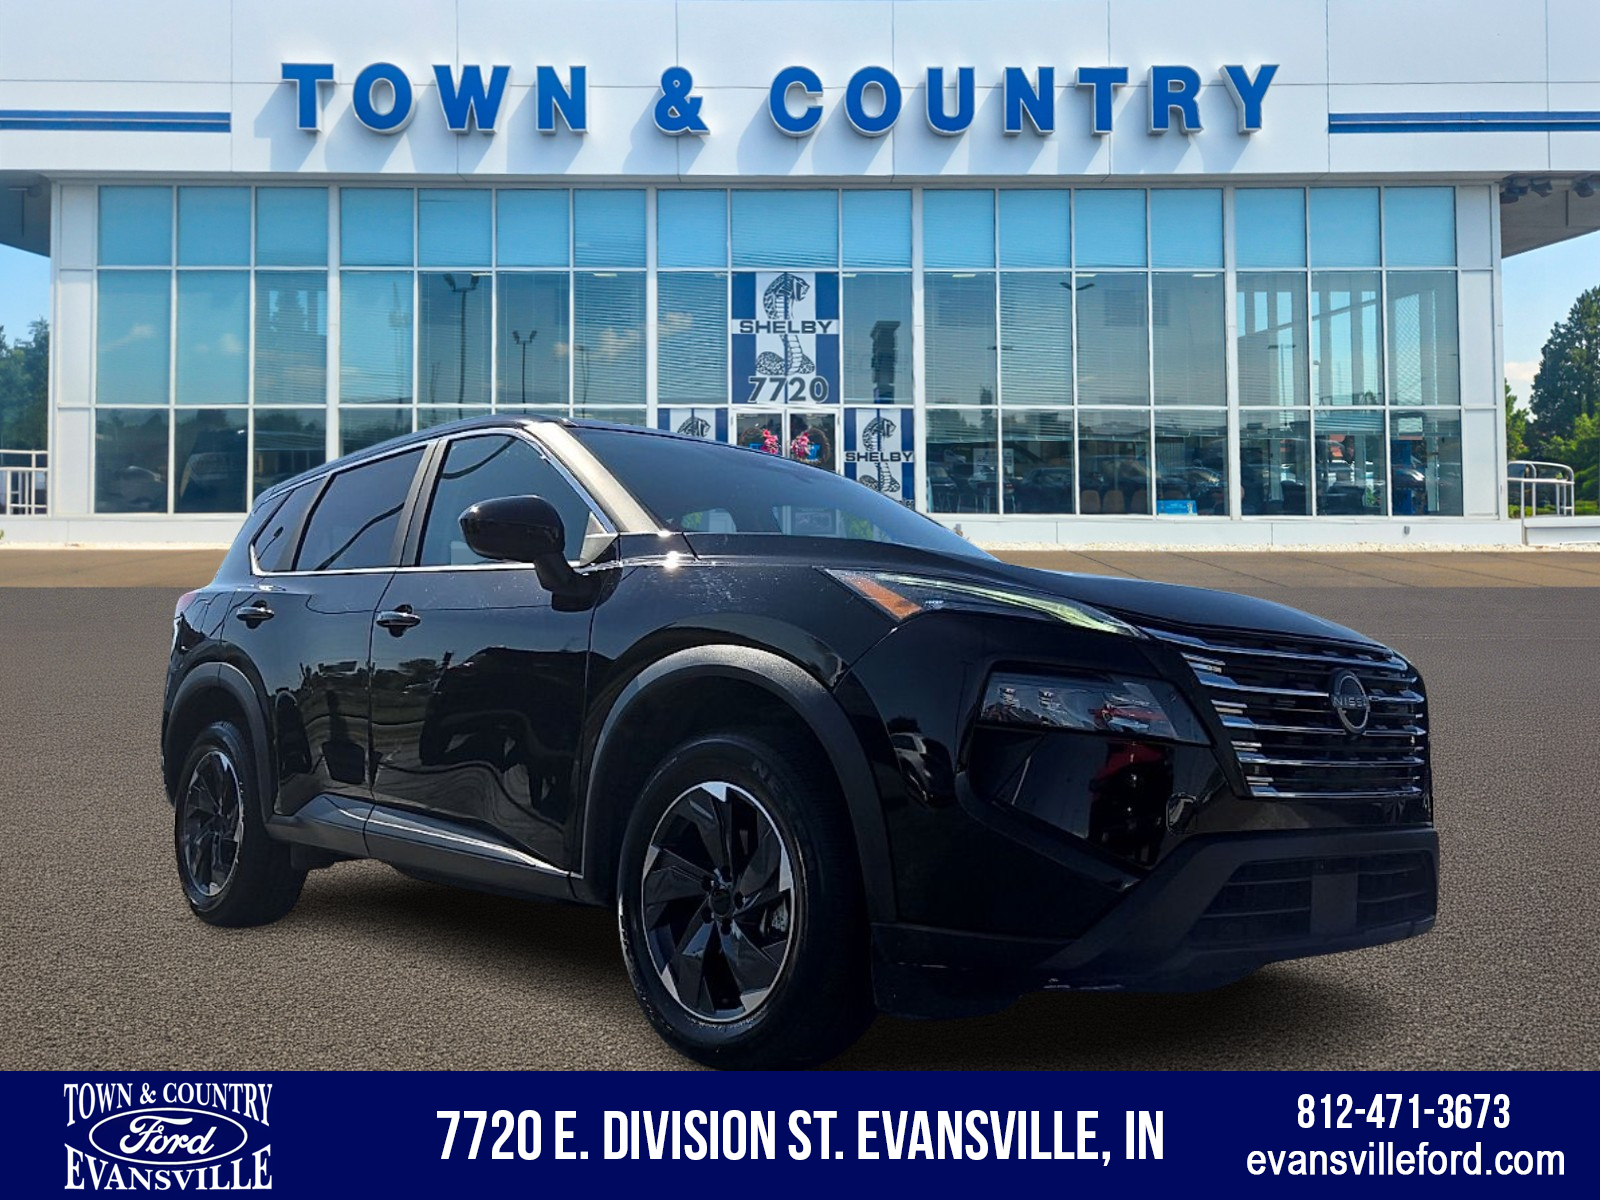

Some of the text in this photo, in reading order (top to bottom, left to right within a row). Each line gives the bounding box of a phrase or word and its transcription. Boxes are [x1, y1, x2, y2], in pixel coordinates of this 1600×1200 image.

[281, 62, 1280, 137] TOWN & COUNTRY
[739, 320, 833, 335] SHELBY
[748, 376, 829, 403] 7720
[845, 451, 914, 463] SHELBY
